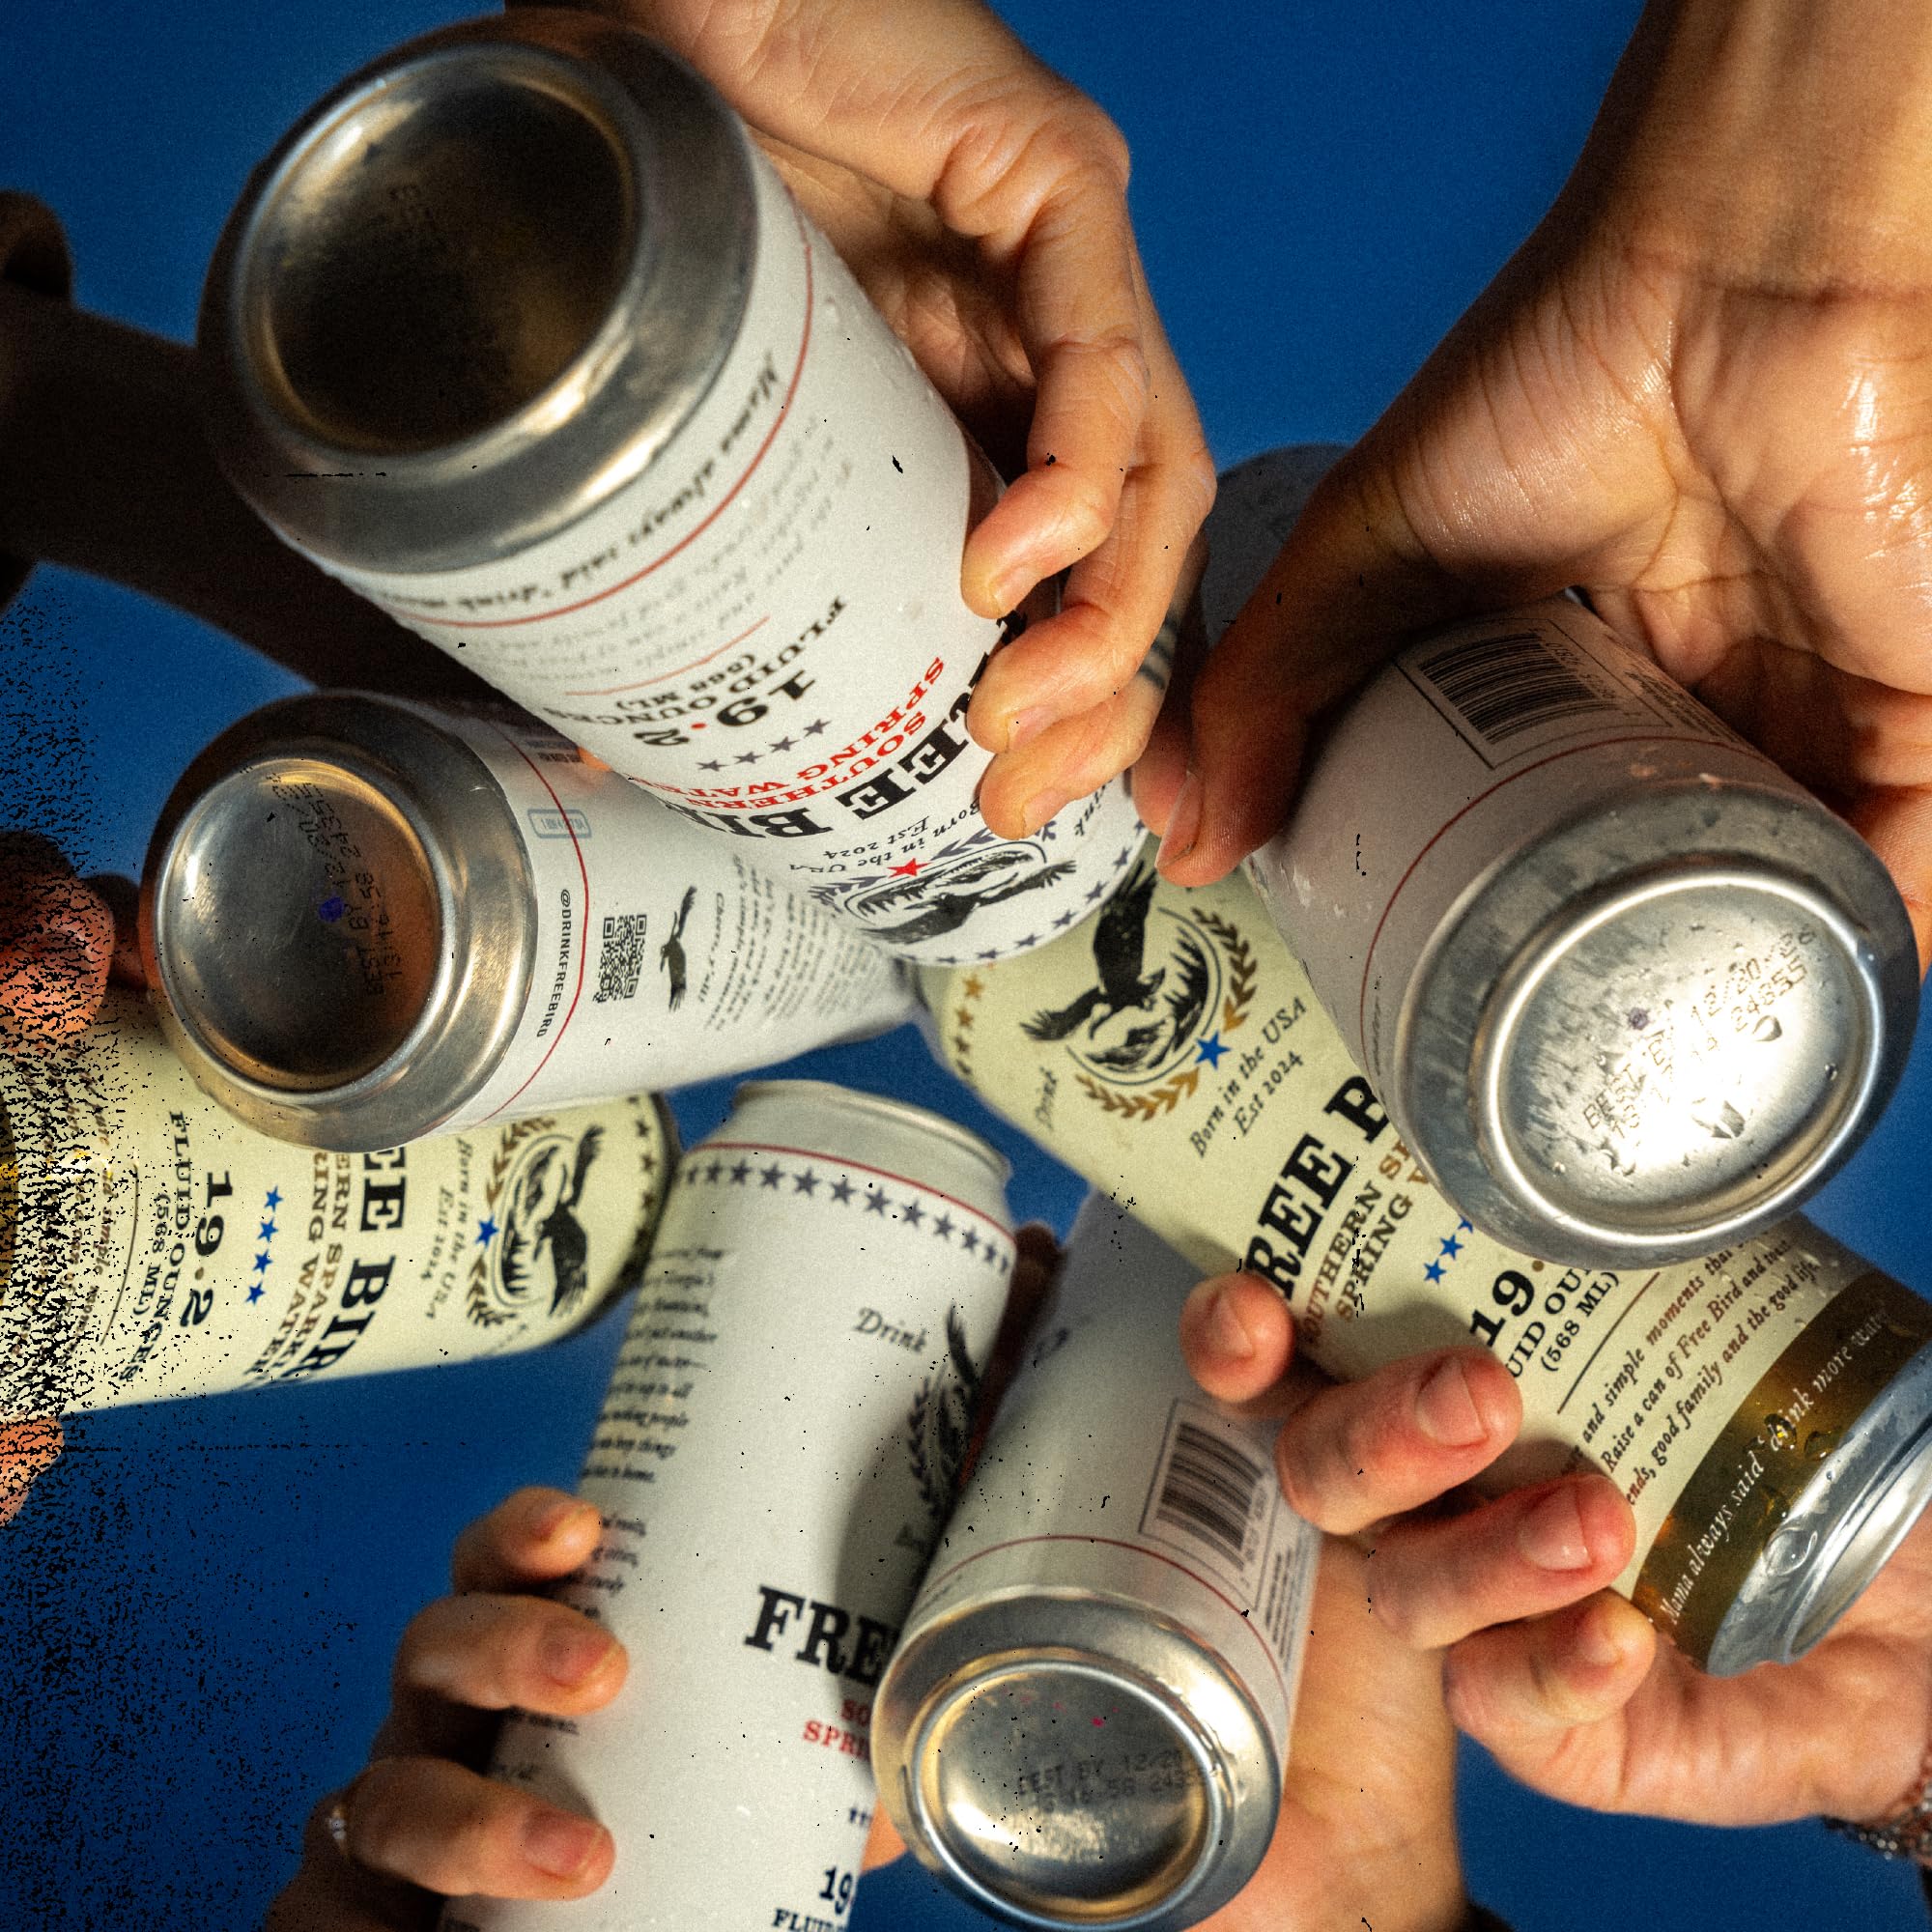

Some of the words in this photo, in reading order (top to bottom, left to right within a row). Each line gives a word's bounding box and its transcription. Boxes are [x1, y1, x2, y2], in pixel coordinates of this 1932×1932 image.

[729, 595, 847, 694] FLUID
[796, 656, 945, 781] SPRING
[822, 841, 879, 861] 2024
[857, 850, 892, 867] the
[886, 815, 931, 847] Est
[901, 838, 925, 854] in
[535, 888, 573, 1038] @DRINKFREEBIRD
[1188, 1106, 1225, 1158] Born
[1222, 1082, 1241, 1104] in
[1239, 1043, 1265, 1080] the
[1262, 995, 1308, 1045] USA
[1232, 1092, 1265, 1137] Est
[1263, 1049, 1305, 1097] 2024
[167, 1109, 193, 1233] FLUID
[1244, 1132, 1354, 1302] REE
[150, 1192, 172, 1256] (568
[1334, 1192, 1414, 1322] SPRING
[131, 1263, 162, 1317] ML)
[855, 1306, 928, 1353] Drink
[1540, 1319, 1581, 1373] (568
[1575, 1270, 1621, 1319] ML)
[1505, 1320, 1547, 1379] UID
[1581, 1402, 1606, 1444] and
[1604, 1347, 1646, 1408] simple
[1645, 1275, 1706, 1347] moments
[1599, 1425, 1636, 1474] Raise
[1633, 1410, 1645, 1428] a
[1642, 1377, 1667, 1412] can
[1664, 1351, 1686, 1380] of
[1676, 1320, 1713, 1361] Free
[1706, 1279, 1745, 1324] Bird
[1741, 1256, 1768, 1289] and
[1625, 1464, 1658, 1507] ends,
[1650, 1412, 1681, 1467] good
[1675, 1358, 1724, 1430] family
[1720, 1327, 1749, 1365] and
[1746, 1303, 1772, 1332] the
[1767, 1270, 1799, 1313] good
[1660, 1574, 1693, 1626] Mama
[1687, 1503, 1736, 1577] always
[1729, 1449, 1766, 1506] said
[1812, 1345, 1854, 1395] more
[743, 1584, 900, 1689] FRE
